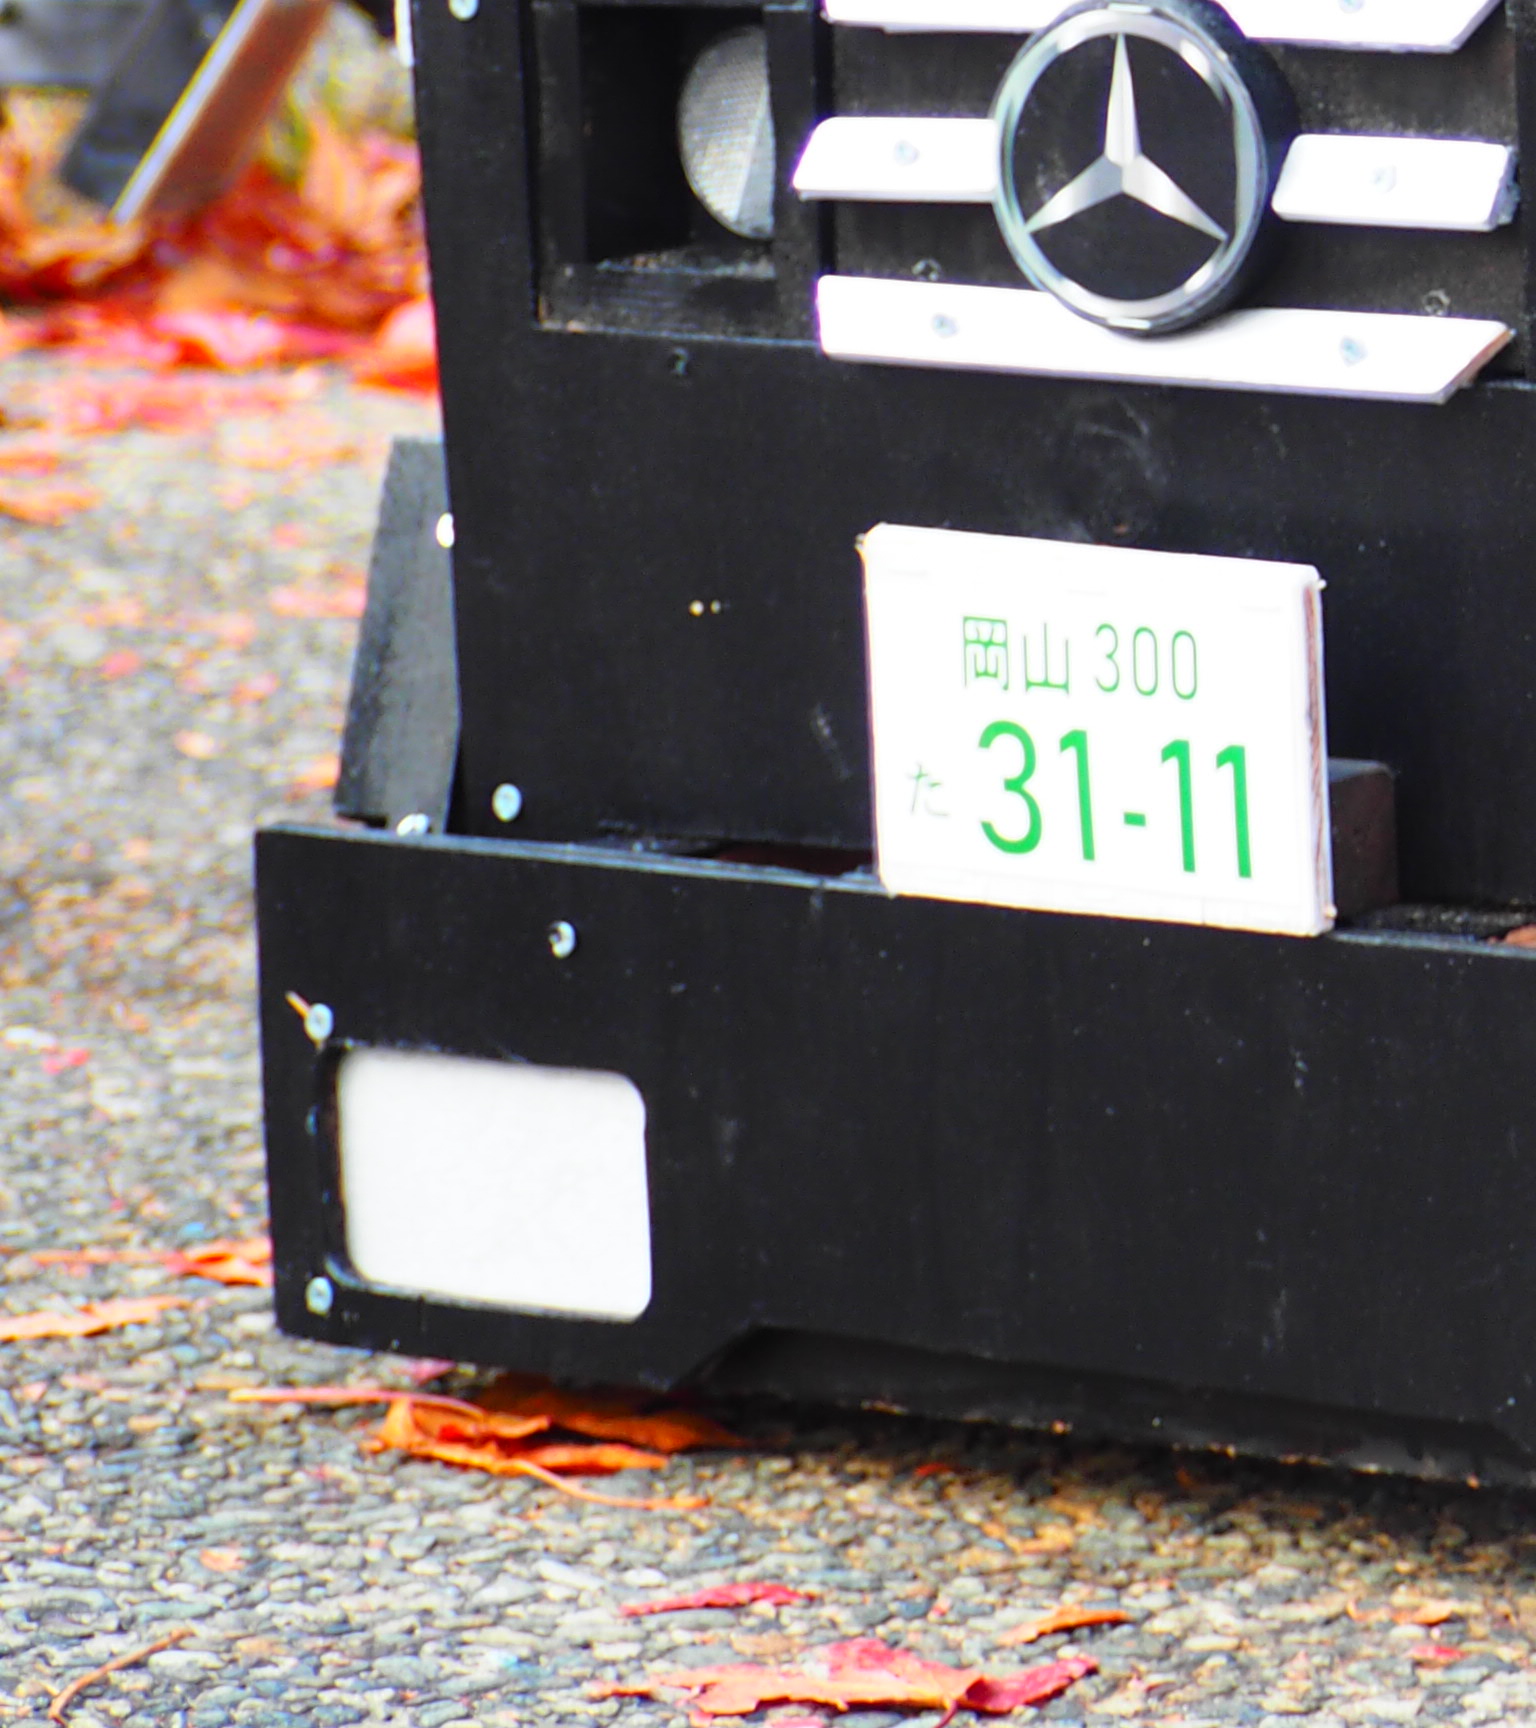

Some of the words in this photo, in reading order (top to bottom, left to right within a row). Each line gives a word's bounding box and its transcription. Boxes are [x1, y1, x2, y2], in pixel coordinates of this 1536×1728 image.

[963, 616, 1071, 696] 岡山
[1095, 623, 1199, 702] 300
[908, 761, 949, 818] た
[978, 720, 1253, 880] 31-11
